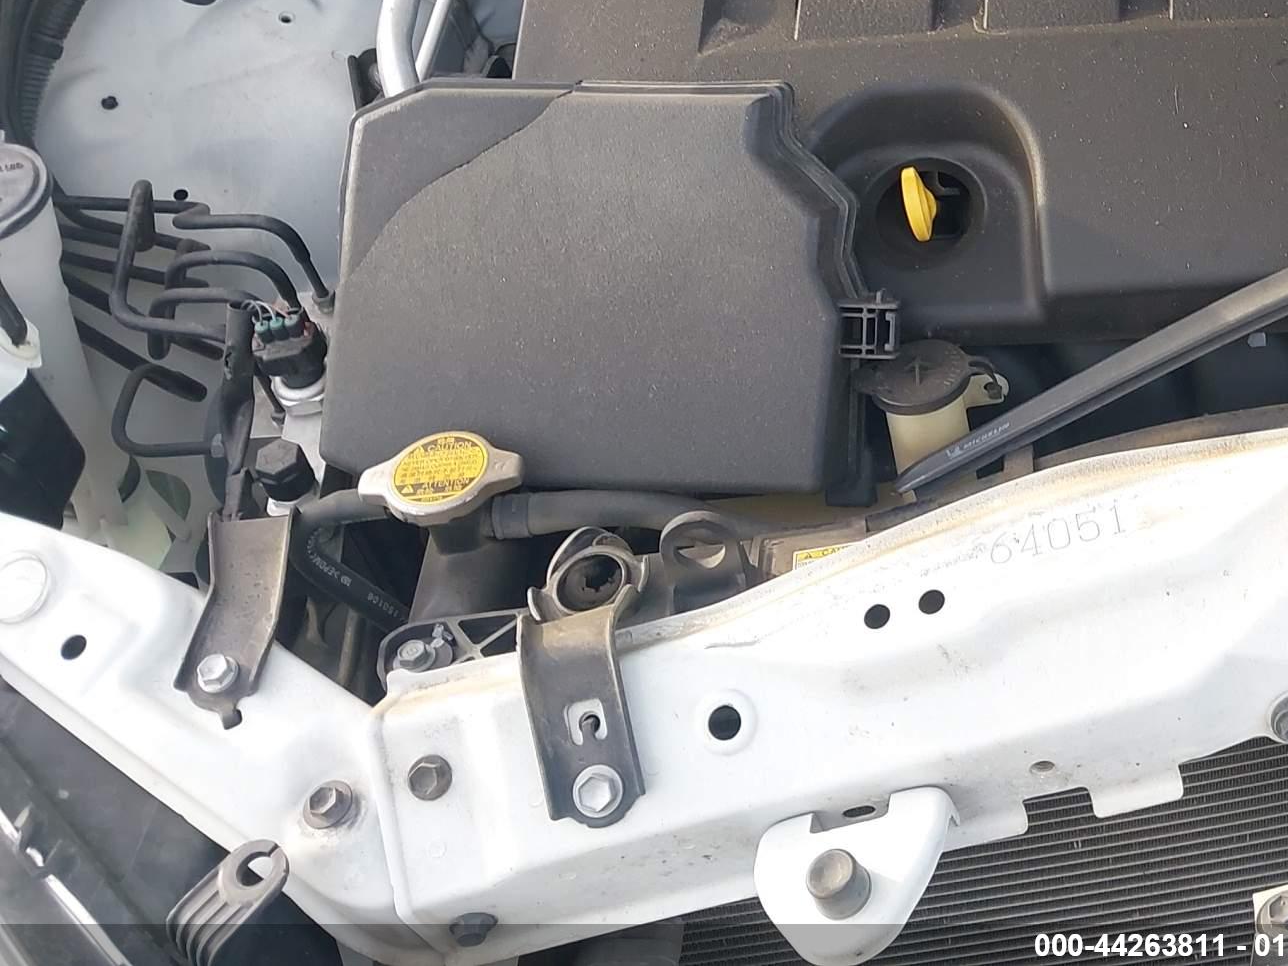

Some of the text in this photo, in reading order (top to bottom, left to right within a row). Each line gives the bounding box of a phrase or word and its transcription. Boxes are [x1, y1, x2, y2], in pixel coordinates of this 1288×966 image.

[963, 422, 1010, 450] MICHELIN
[427, 441, 472, 453] CAUTION
[421, 477, 470, 489] ATTENTION
[990, 499, 1126, 565] 64051
